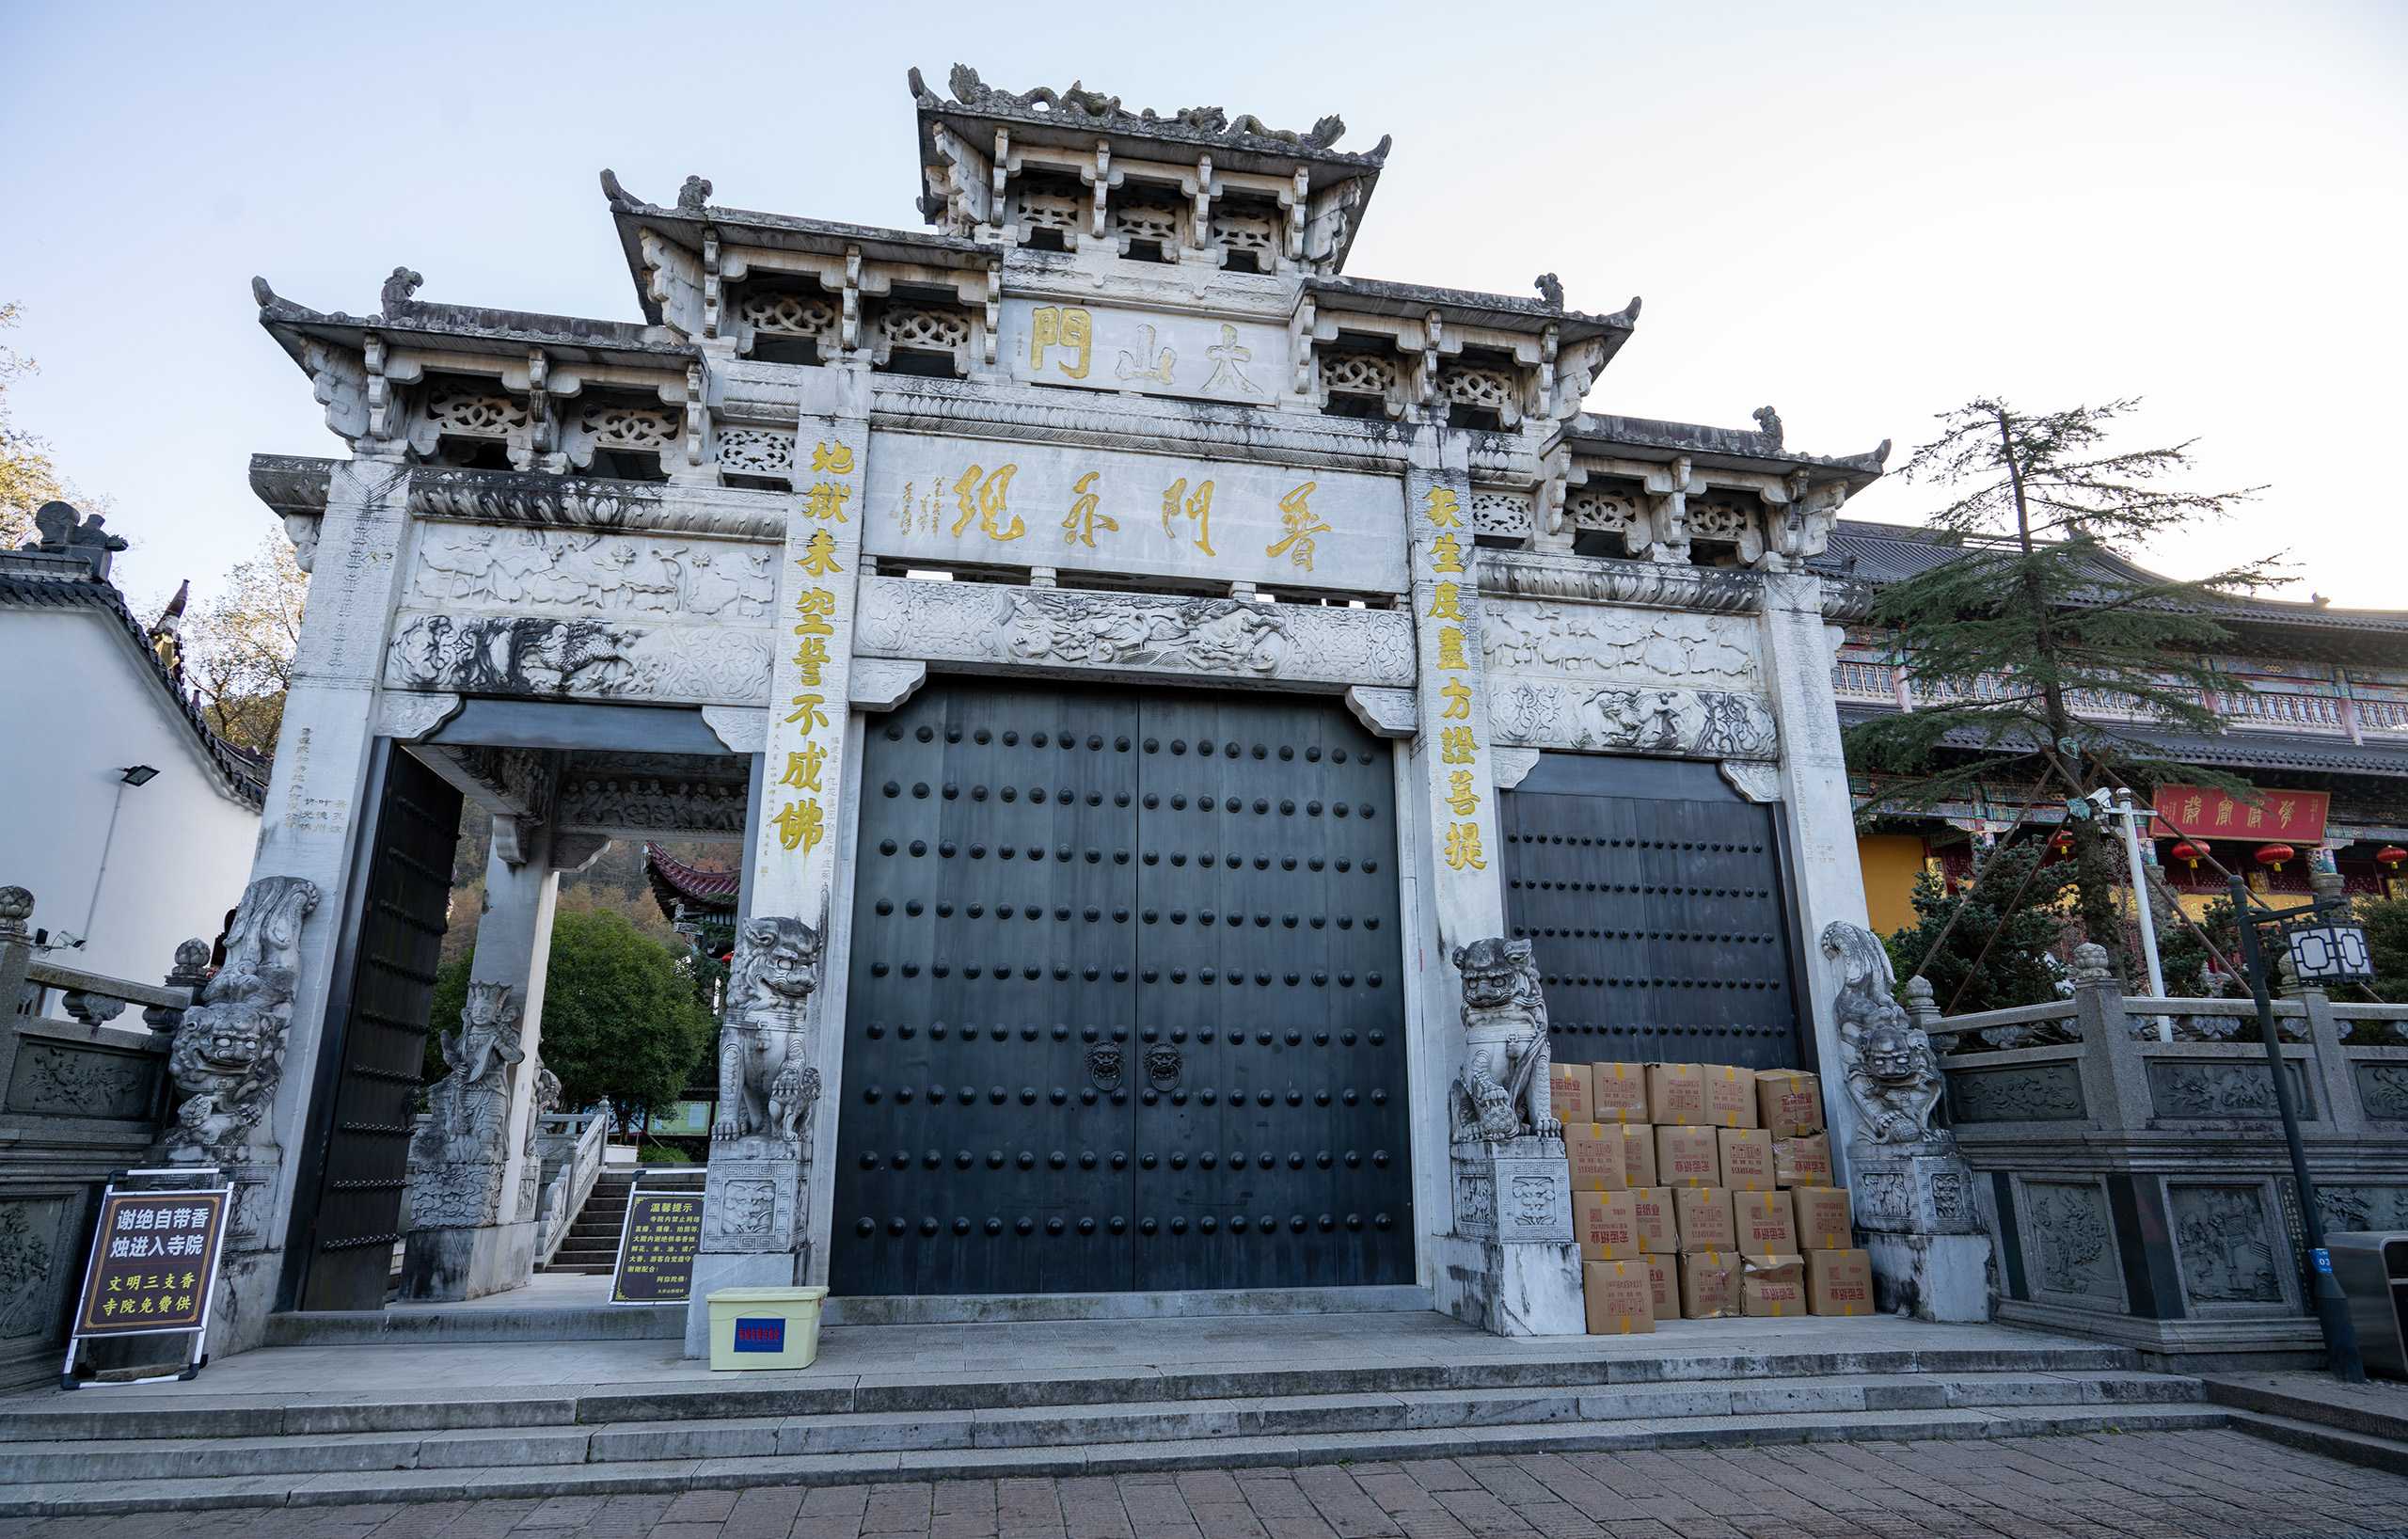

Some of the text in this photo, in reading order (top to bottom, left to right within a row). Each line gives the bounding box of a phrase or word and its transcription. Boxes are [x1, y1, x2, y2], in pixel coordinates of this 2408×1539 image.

[770, 439, 855, 857] 地獄未空誓不成佛
[650, 1202, 693, 1213] 温馨提示
[116, 1207, 210, 1231] 谢绝自带香
[1590, 1230, 1629, 1245] 宏运纸业
[1752, 1228, 1786, 1240] 宏运纸业
[109, 1233, 204, 1259] 烛进入寺院
[2319, 1258, 2331, 1266] 03
[106, 1272, 197, 1292] 文明三支香
[103, 1294, 192, 1317] 寺院免费供
